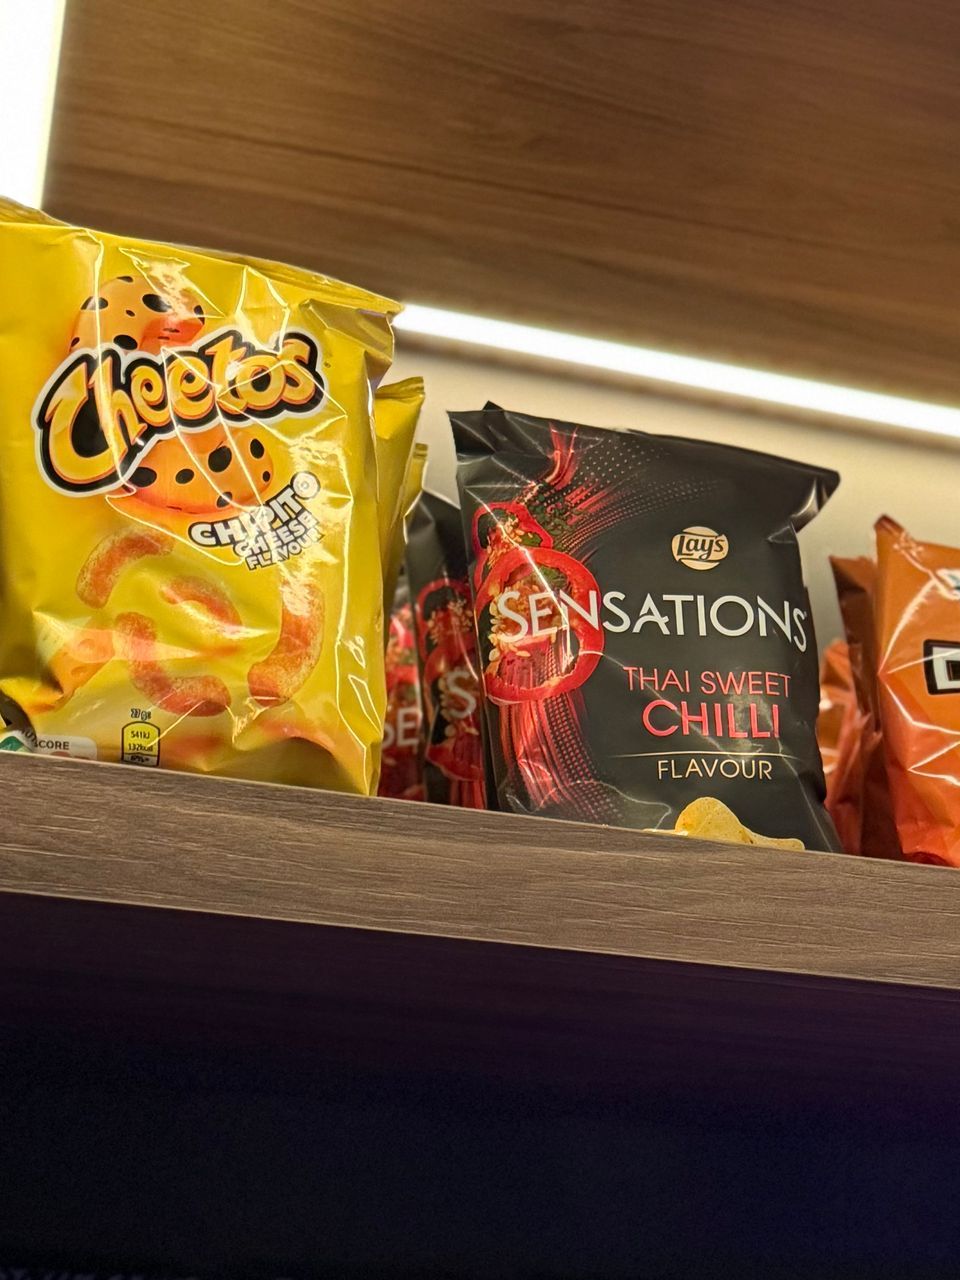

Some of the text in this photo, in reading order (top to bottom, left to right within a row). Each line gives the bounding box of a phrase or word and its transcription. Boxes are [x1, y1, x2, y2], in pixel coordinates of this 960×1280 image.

[40, 332, 320, 490] Cheetos
[233, 511, 319, 557] CHEESE
[245, 527, 324, 570] FLAVOUR
[677, 532, 727, 561] Lay's
[498, 589, 807, 653] SENSATIONS
[622, 666, 791, 698] THAI SWEET
[642, 700, 780, 738] CHILLI
[658, 758, 773, 780] FLAVOUR
